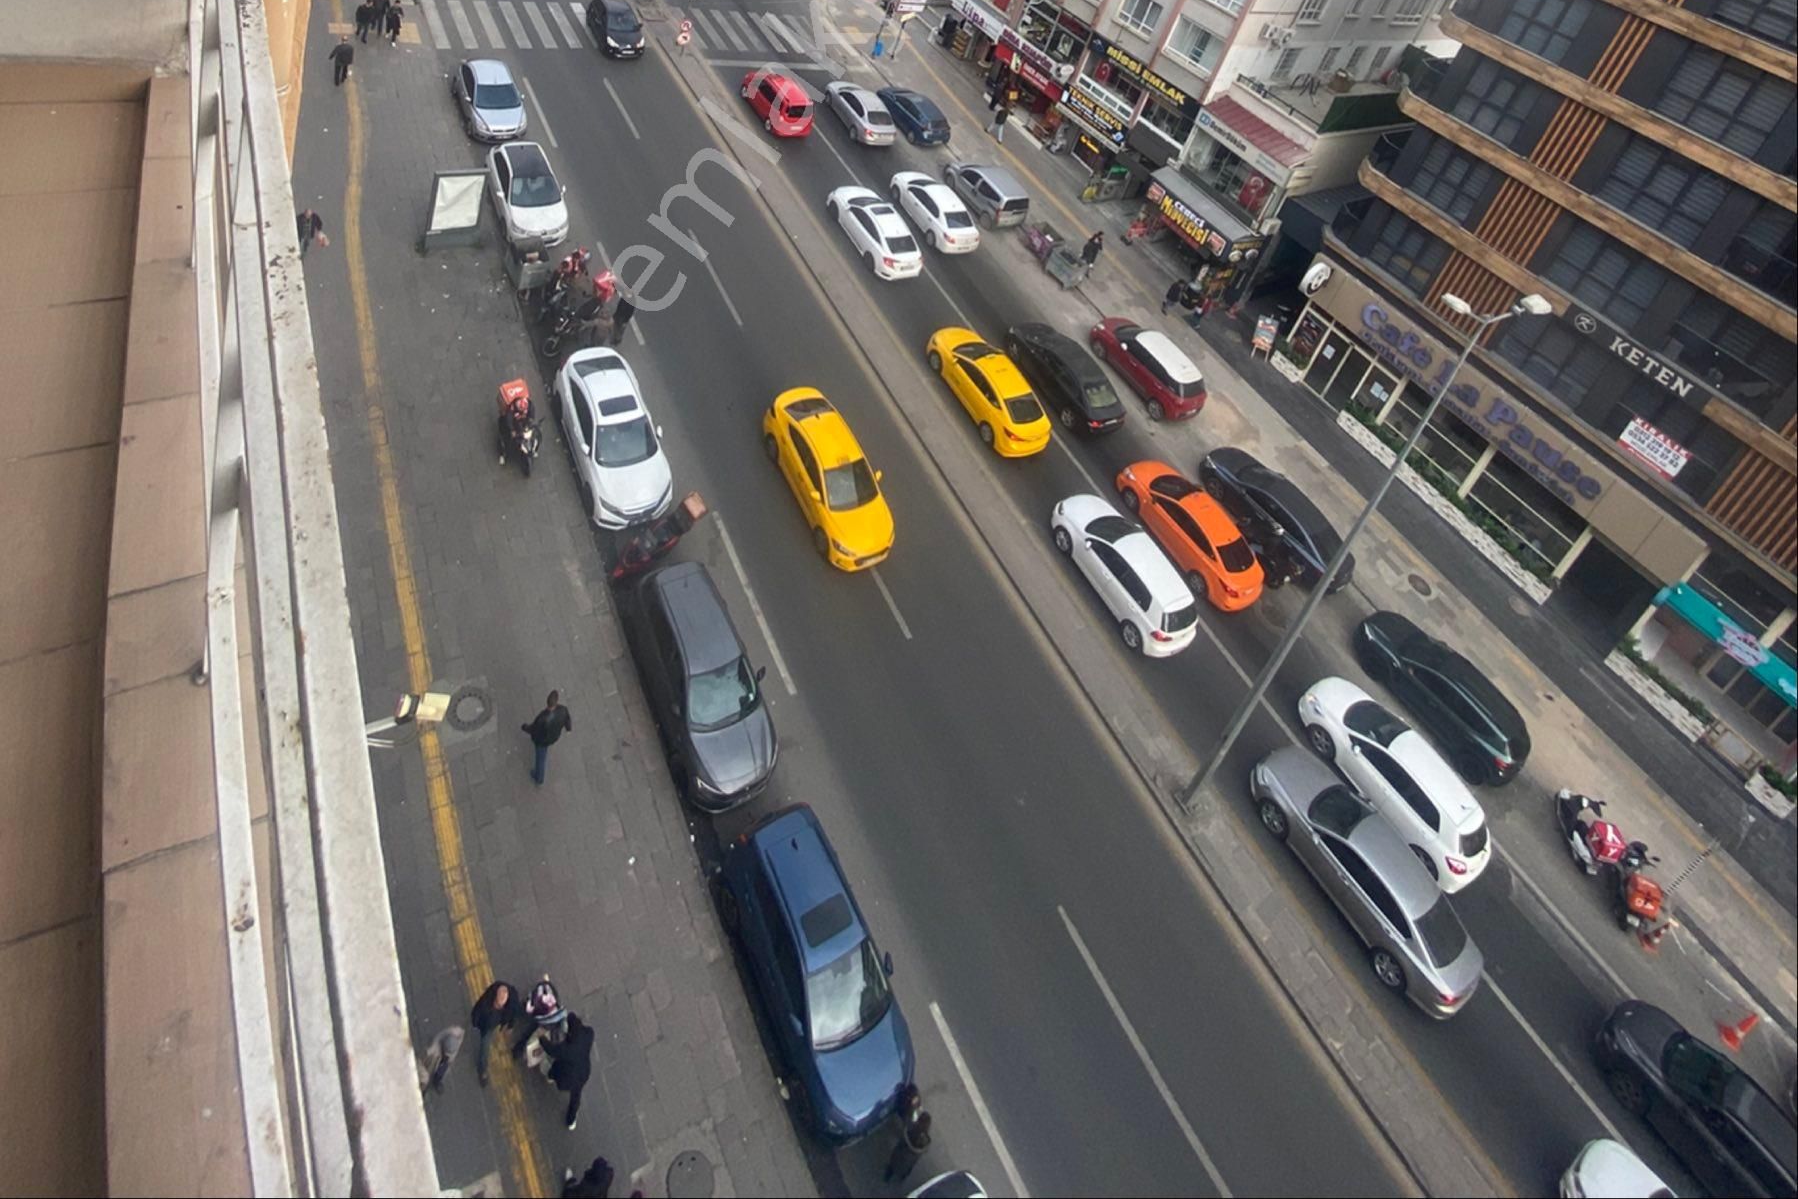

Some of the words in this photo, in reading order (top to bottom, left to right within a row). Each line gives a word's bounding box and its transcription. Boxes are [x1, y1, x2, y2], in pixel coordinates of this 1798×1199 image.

[1142, 69, 1187, 105] EMLAK
[1609, 335, 1694, 397] KETEN
[1484, 397, 1602, 500] Pause
